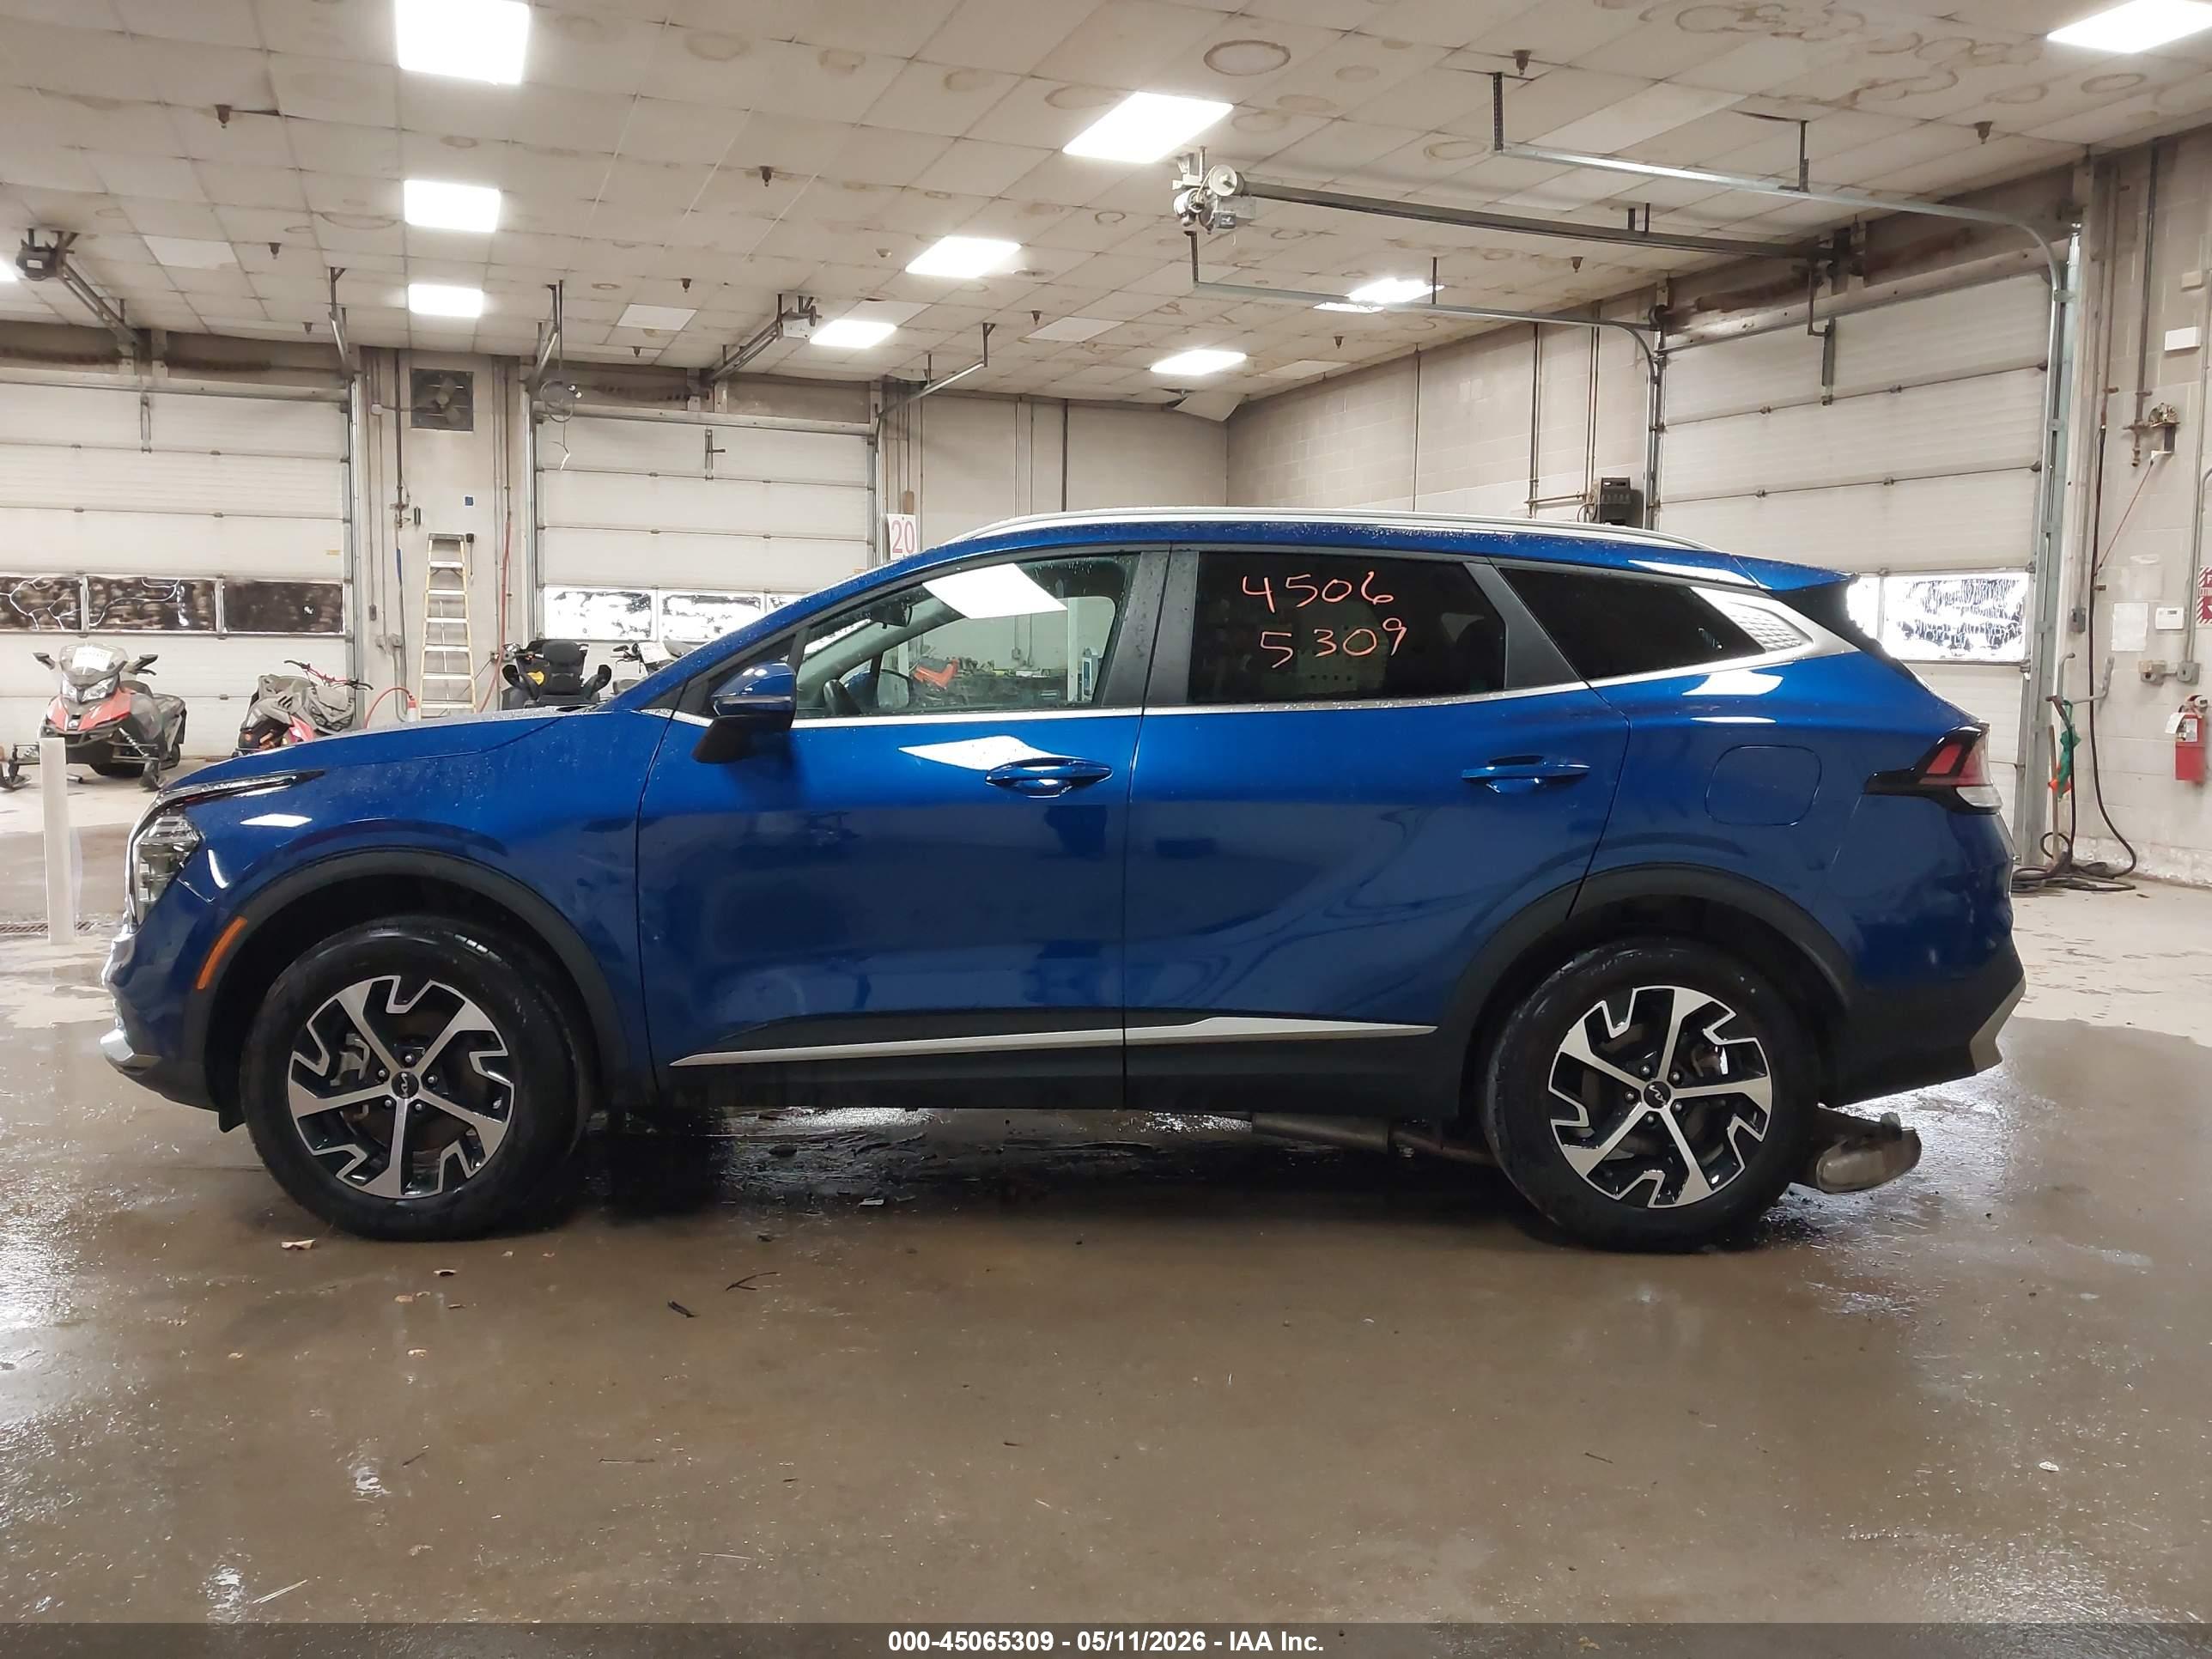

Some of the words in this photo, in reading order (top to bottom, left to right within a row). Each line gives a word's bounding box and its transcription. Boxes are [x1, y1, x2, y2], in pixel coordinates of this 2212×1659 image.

[891, 520, 915, 555] 20
[1242, 571, 1395, 613] 4506
[1260, 617, 1407, 669] 5309
